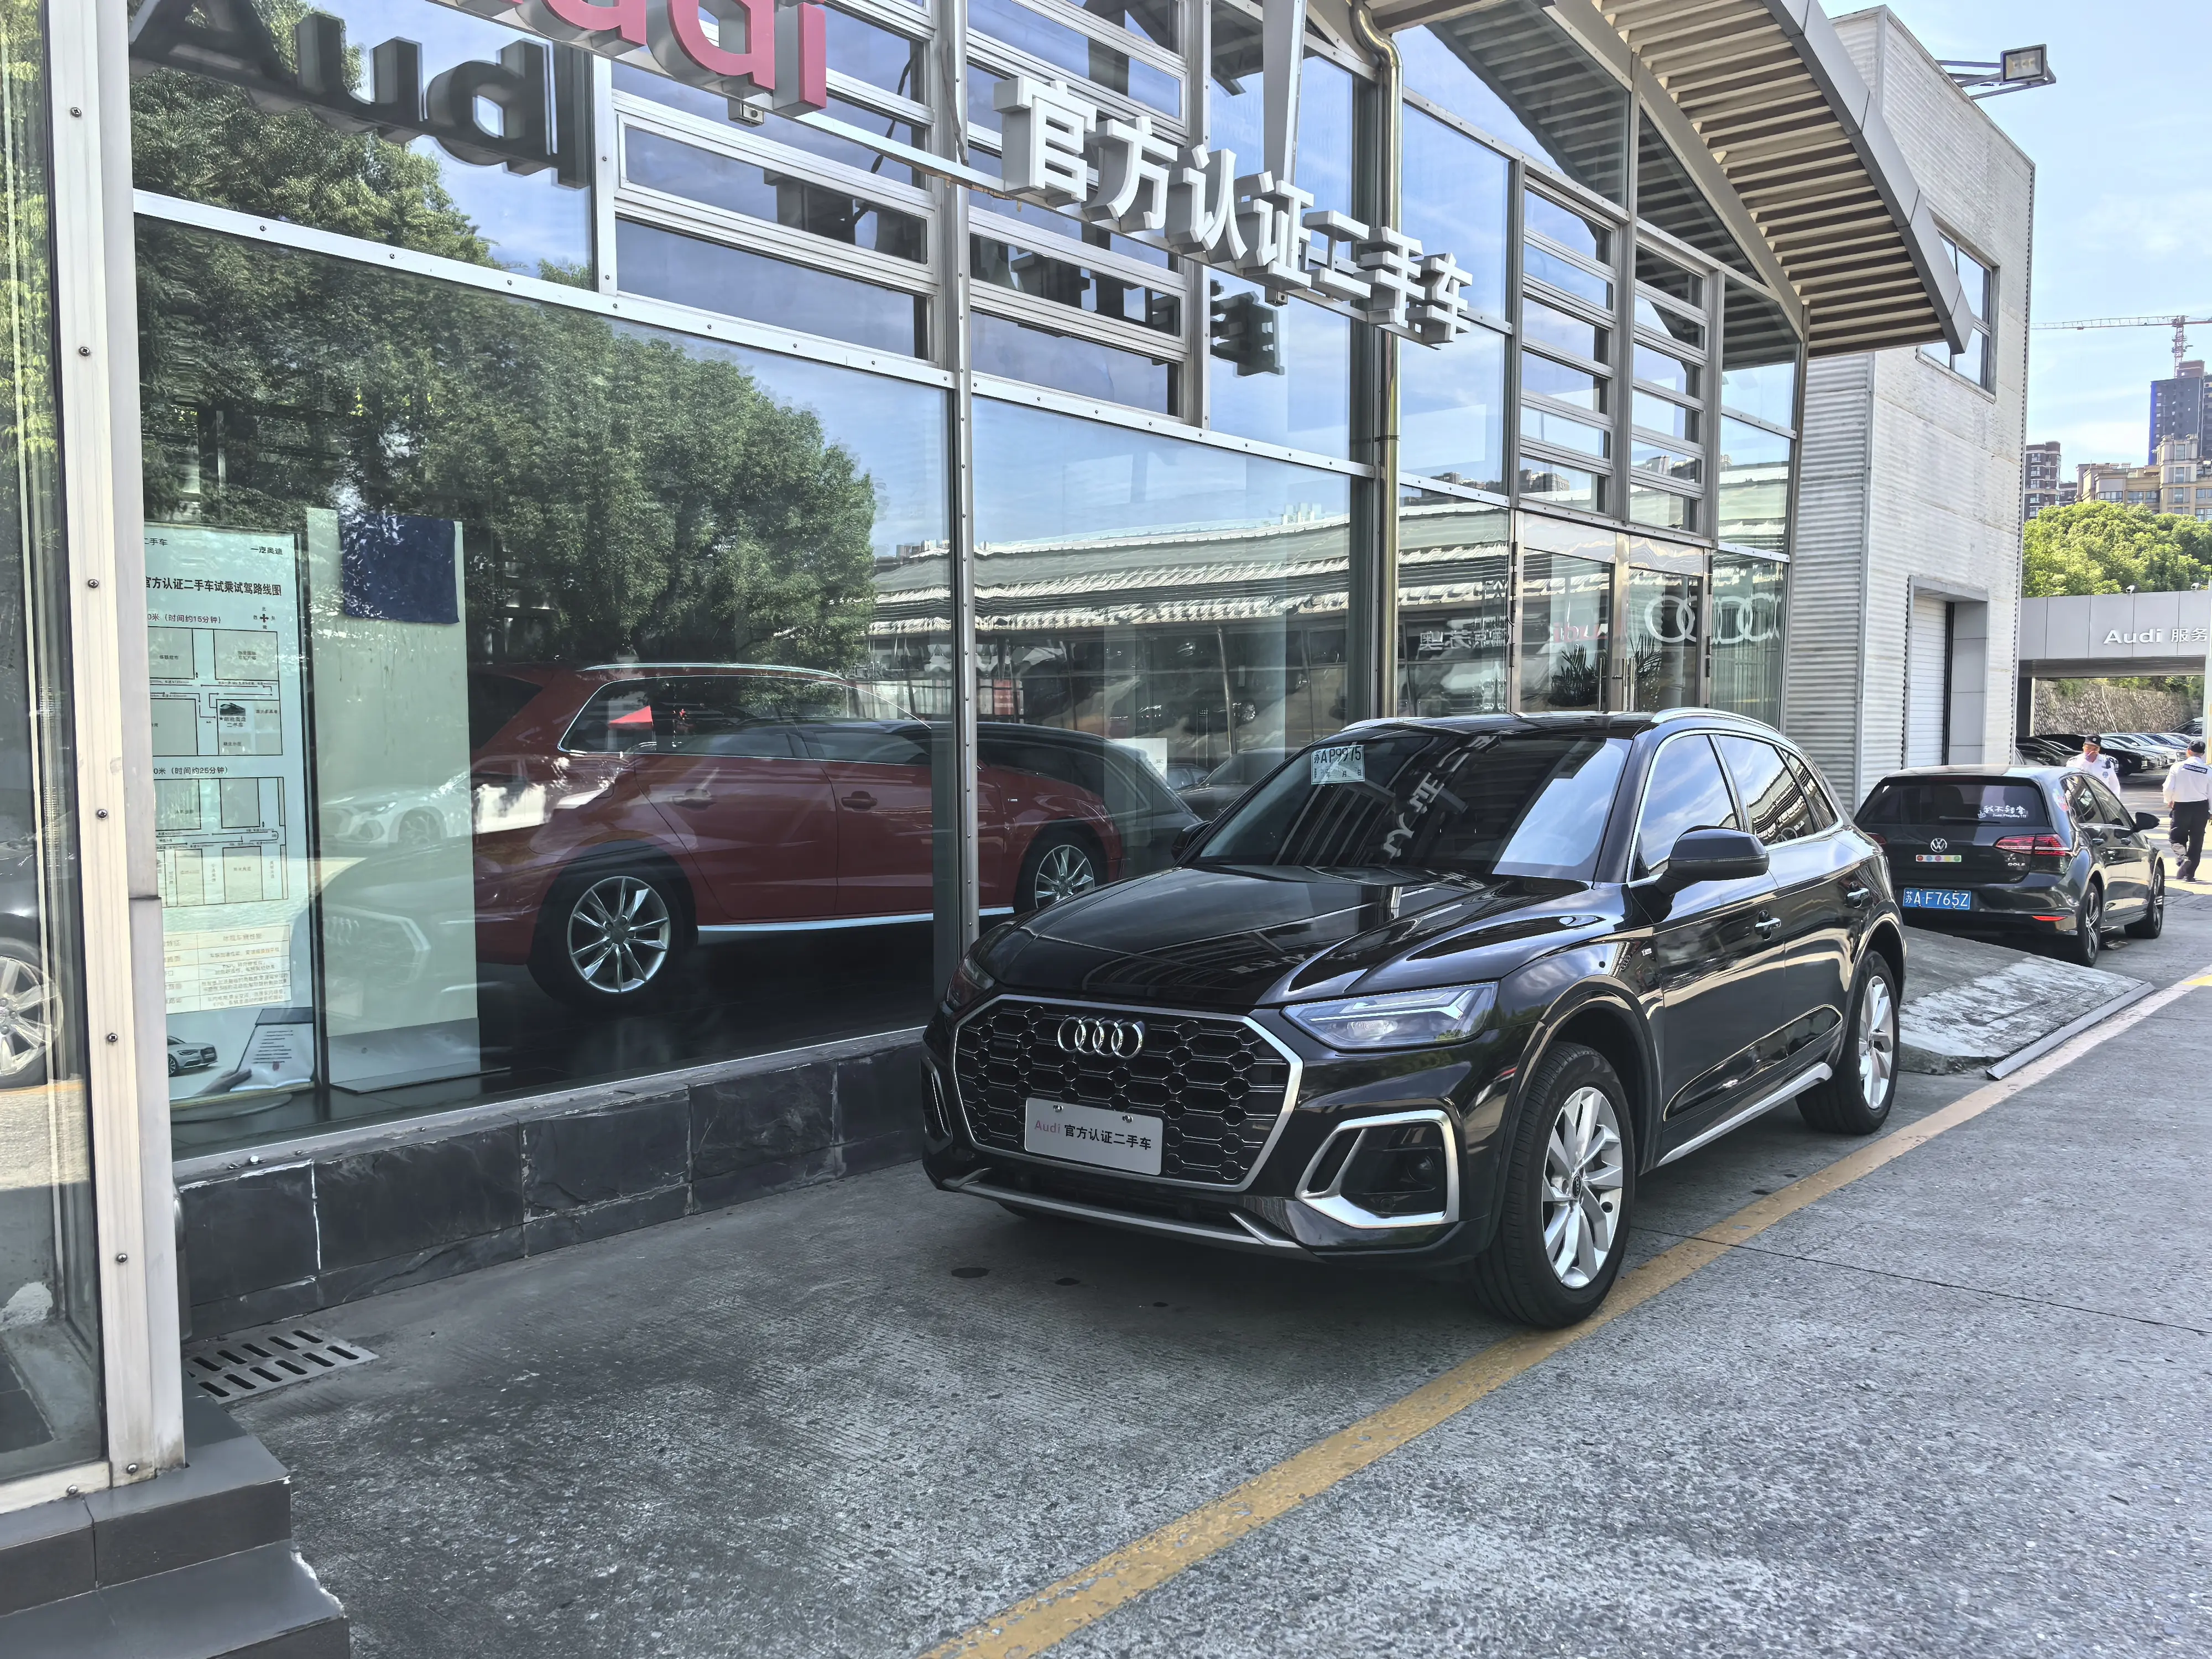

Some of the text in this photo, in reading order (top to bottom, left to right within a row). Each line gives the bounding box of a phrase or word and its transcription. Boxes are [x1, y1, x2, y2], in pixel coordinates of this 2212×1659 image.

[995, 75, 1473, 344] 官方认证二手车
[146, 576, 281, 596] 官方认证二手车试乘试驾路线图
[2104, 628, 2208, 644] Audi 服务
[1035, 1120, 1151, 1150] Audi 官方认证二手车
